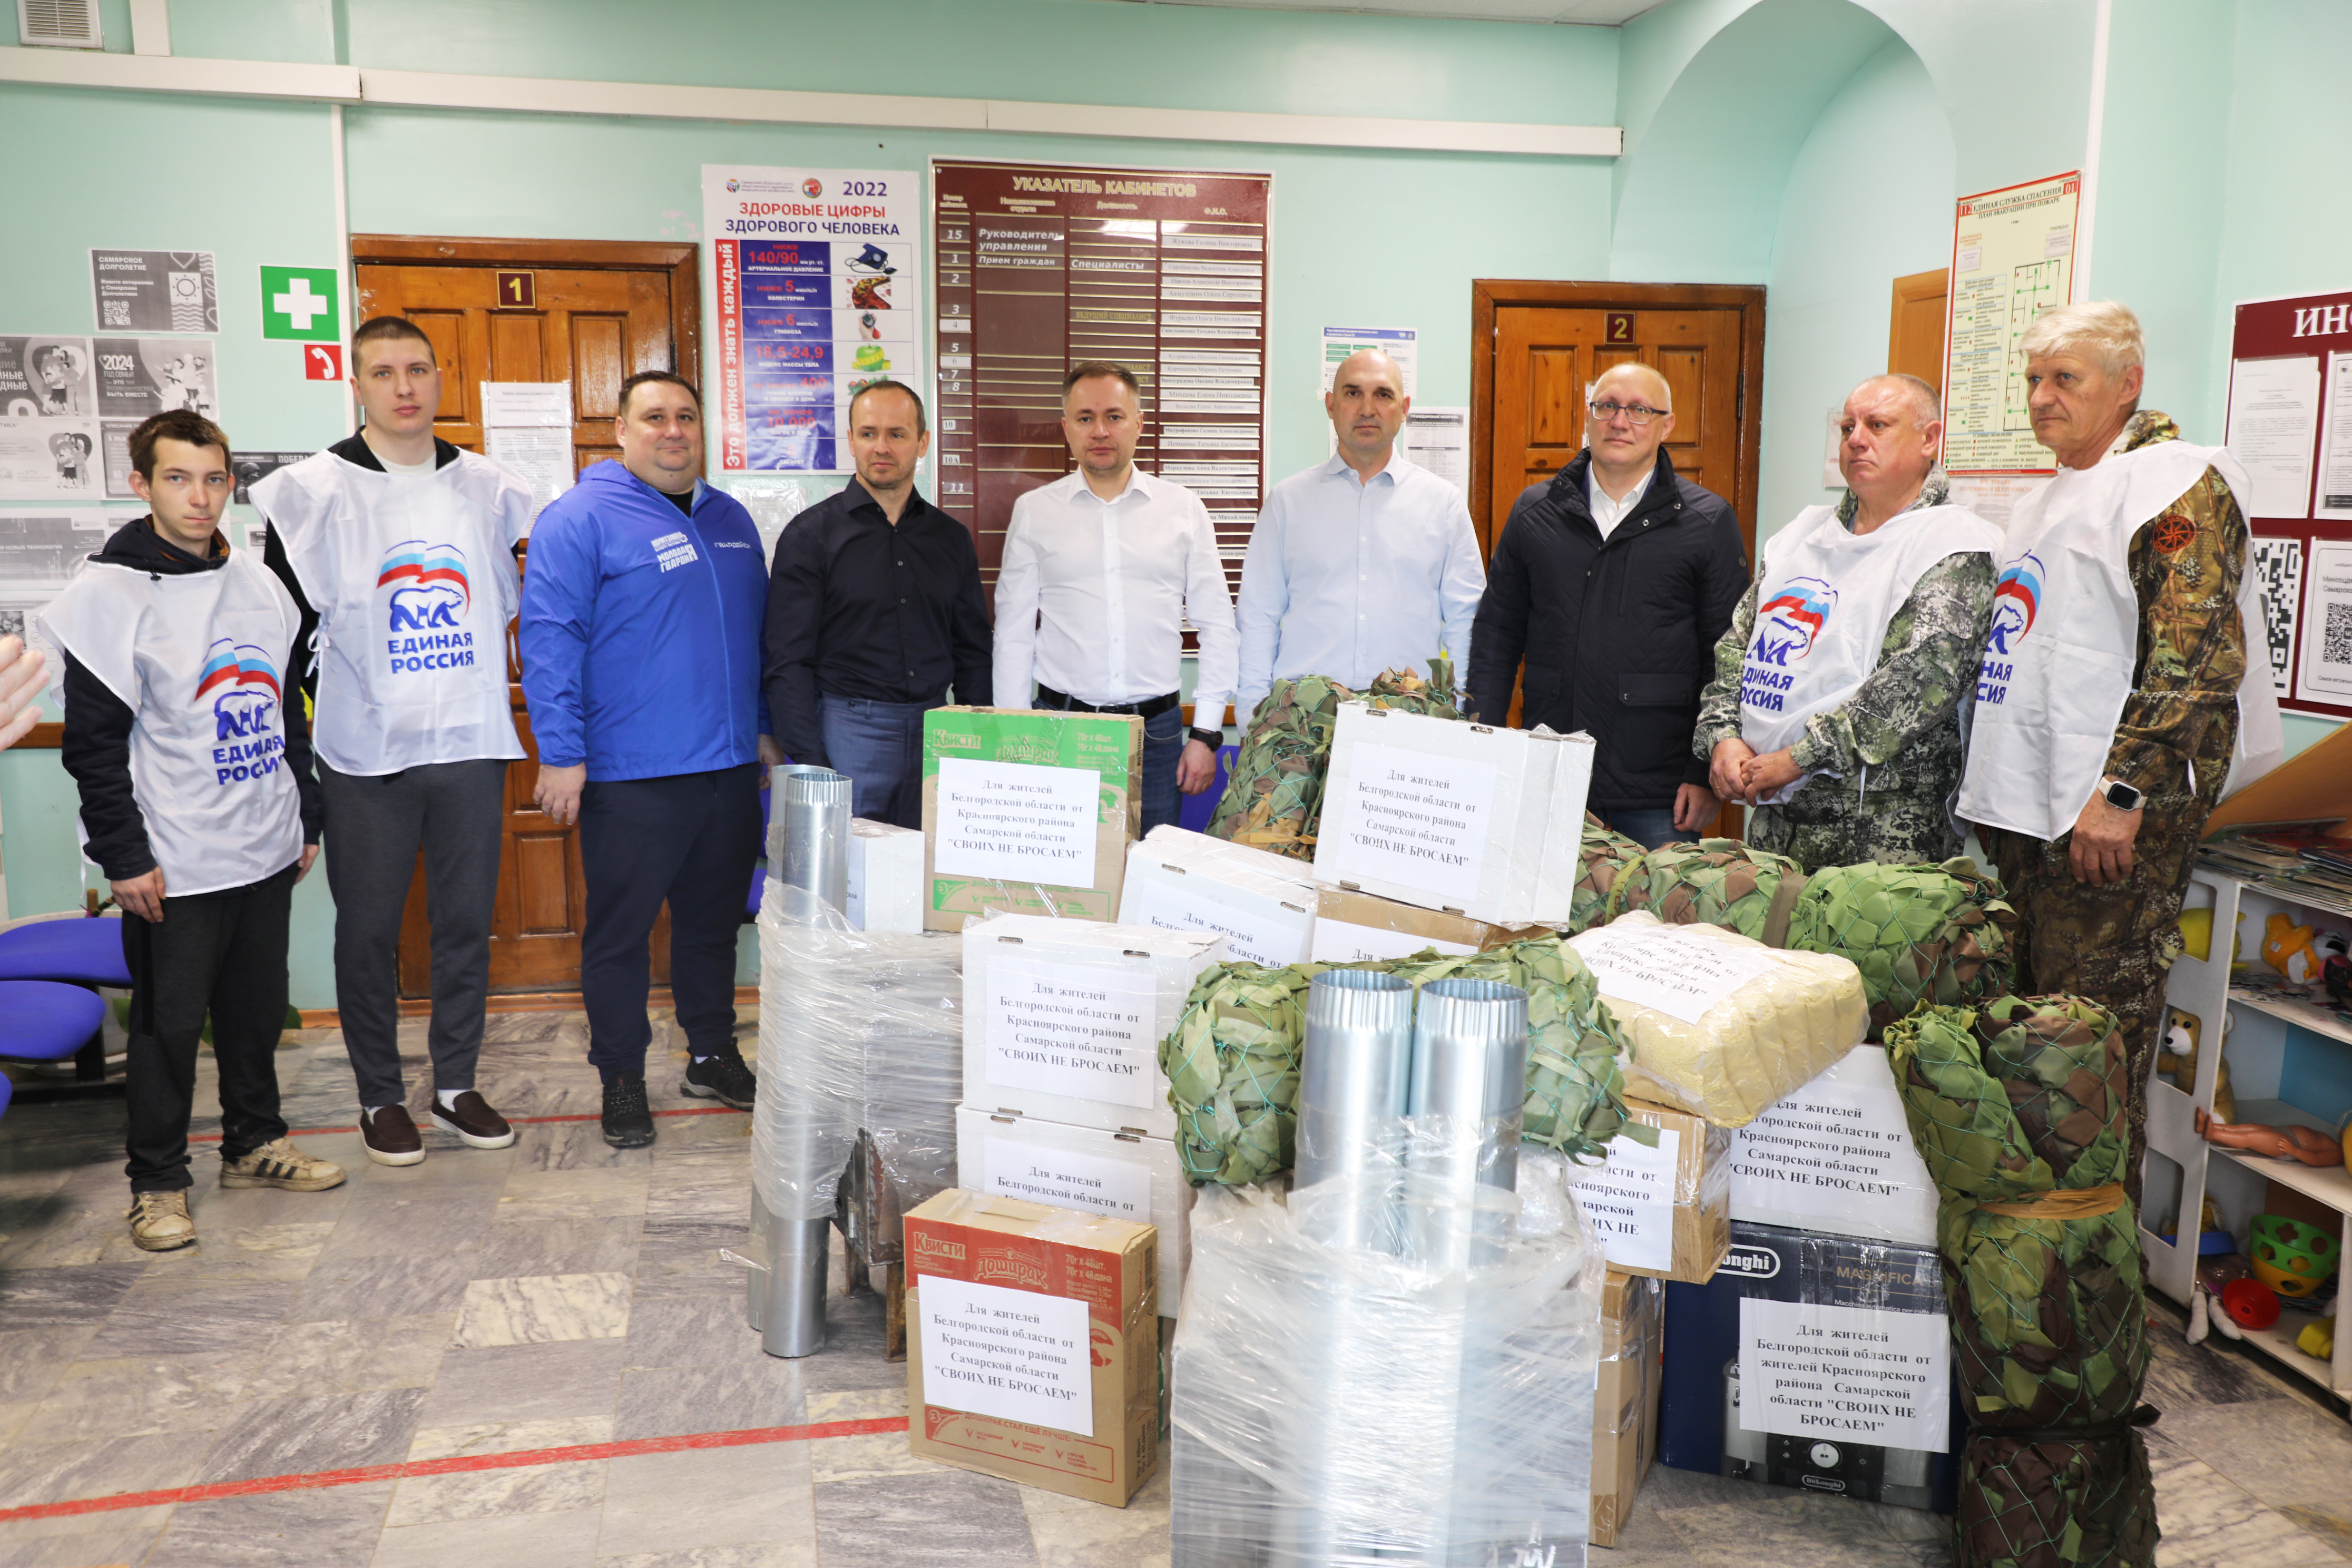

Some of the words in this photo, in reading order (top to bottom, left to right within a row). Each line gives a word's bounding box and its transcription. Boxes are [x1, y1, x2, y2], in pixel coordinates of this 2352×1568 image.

[843, 181, 888, 197] 2022
[1012, 176, 1102, 194] УКАЗАТЕЛЬ
[1106, 180, 1197, 198] КАБИНЕТОВ
[1960, 204, 1972, 216] 112
[1973, 201, 1998, 212] ЕДИНАЯ
[2000, 195, 2025, 206] СЛУЖБА
[2026, 187, 2062, 201] СПАСЕНИЯ
[2065, 183, 2075, 194] 01
[1993, 205, 2024, 216] ЭВАКУАЦИИ
[2037, 197, 2060, 208] ПОЖАРЕ
[739, 202, 824, 217] ЗДОРОВЫЕ
[828, 205, 886, 219] ЦИФРЫ
[726, 220, 817, 233] ЗДОРОВОГО
[822, 222, 900, 236] ЧЕЛОВЕКА
[947, 230, 962, 240] 15
[979, 228, 1060, 239] Руководитель
[979, 242, 1047, 251] управления
[748, 251, 799, 264] 140/90
[952, 254, 958, 263] 1
[979, 256, 1011, 265] Прием
[1013, 258, 1055, 267] граждан
[1072, 259, 1144, 270] Специалисты
[509, 277, 522, 301] 1
[719, 243, 736, 314] каждый
[785, 280, 795, 292] 5
[952, 274, 959, 283] 2
[786, 314, 795, 326] 6
[952, 305, 959, 315] 3
[1076, 311, 1108, 320] ВЕДУЩИЙ
[1110, 312, 1152, 320] СПЕЦИАЛИСТ
[1614, 318, 1628, 339] 2
[2292, 305, 2352, 338] ИН
[726, 318, 737, 365] знать
[952, 343, 959, 352] 5
[104, 355, 135, 370] 2024
[755, 346, 824, 360] 18,5-24,9
[800, 377, 827, 389] 400
[951, 369, 958, 379] 7
[952, 382, 960, 391] 8
[726, 369, 742, 433] должен
[767, 417, 784, 428] 10
[789, 417, 816, 429] 000
[727, 437, 740, 467] Это
[950, 483, 964, 492] 11
[388, 632, 473, 655] ЕДИНАЯ
[391, 651, 474, 674] РОССИЯ
[1979, 661, 2013, 681] НАЯ
[1743, 665, 1794, 691] ДИНАЯ
[1741, 687, 1784, 711] ОССИЯ
[1976, 683, 2006, 704] СИЯ
[217, 755, 283, 785] РОСИ
[1387, 769, 1405, 781] Для
[1410, 775, 1450, 790] жителей
[1358, 782, 1421, 803] Белгородской
[1423, 796, 1461, 810] области
[1466, 803, 1477, 813] от
[1361, 800, 1430, 823] Красноярского
[1432, 815, 1466, 830] района
[1366, 819, 1416, 838] Самарской
[1418, 831, 1456, 847] области
[1350, 832, 1390, 851] "СВОИХ
[1393, 844, 1407, 855] НЕ
[1409, 846, 1469, 867] БРОСАЕМ"
[1805, 1104, 1862, 1119] жителей
[1826, 1124, 1879, 1139] области
[1887, 1132, 1903, 1142] от
[1739, 1130, 1839, 1152] Красноярского
[1843, 1145, 1891, 1159] района
[1748, 1148, 1821, 1168] Самарской
[1825, 1160, 1878, 1175] области
[1790, 1172, 1810, 1184] НЕ
[1815, 1176, 1899, 1196] БРОСАЕМ"
[1066, 1254, 1078, 1265] 70г
[1723, 1253, 1770, 1271] onghi
[1066, 1266, 1078, 1277] 70г
[1837, 1266, 1923, 1286] MAGNIFICA
[965, 1302, 987, 1315] Для
[993, 1309, 1040, 1324] жителей
[1835, 1299, 1865, 1309] Macchina
[1866, 1304, 1900, 1313] automatica
[934, 1314, 1009, 1337] Белгородской
[1012, 1329, 1056, 1345] области
[1062, 1339, 1074, 1349] от
[1797, 1325, 1823, 1337] Для
[1831, 1329, 1889, 1343] жителей
[942, 1332, 1025, 1358] Красноярского
[1028, 1349, 1067, 1365] района
[1757, 1338, 1849, 1358] Белгородской
[1854, 1349, 1908, 1363] области
[1916, 1356, 1932, 1365] от
[951, 1352, 1012, 1371] Самарской
[1015, 1364, 1059, 1380] области
[1761, 1359, 1817, 1373] жителей
[1821, 1363, 1926, 1383] Красноярского
[935, 1366, 984, 1384] "СВОИХ
[988, 1375, 1005, 1387] НЕ
[1008, 1379, 1077, 1401] БРОСАЕМ"
[1775, 1377, 1822, 1391] района
[1834, 1382, 1910, 1400] Самарской
[1770, 1395, 1822, 1409] области
[1827, 1399, 1890, 1416] "СВОИХ
[1895, 1406, 1916, 1418] НЕ
[965, 1412, 1003, 1426] ДОШИРАК
[1004, 1421, 1023, 1431] СТАЛ
[1025, 1425, 1041, 1435] ЕЩЁ
[1042, 1429, 1072, 1442] ЛУЧШЕ:
[1800, 1414, 1885, 1432] БРОСАЕМ"
